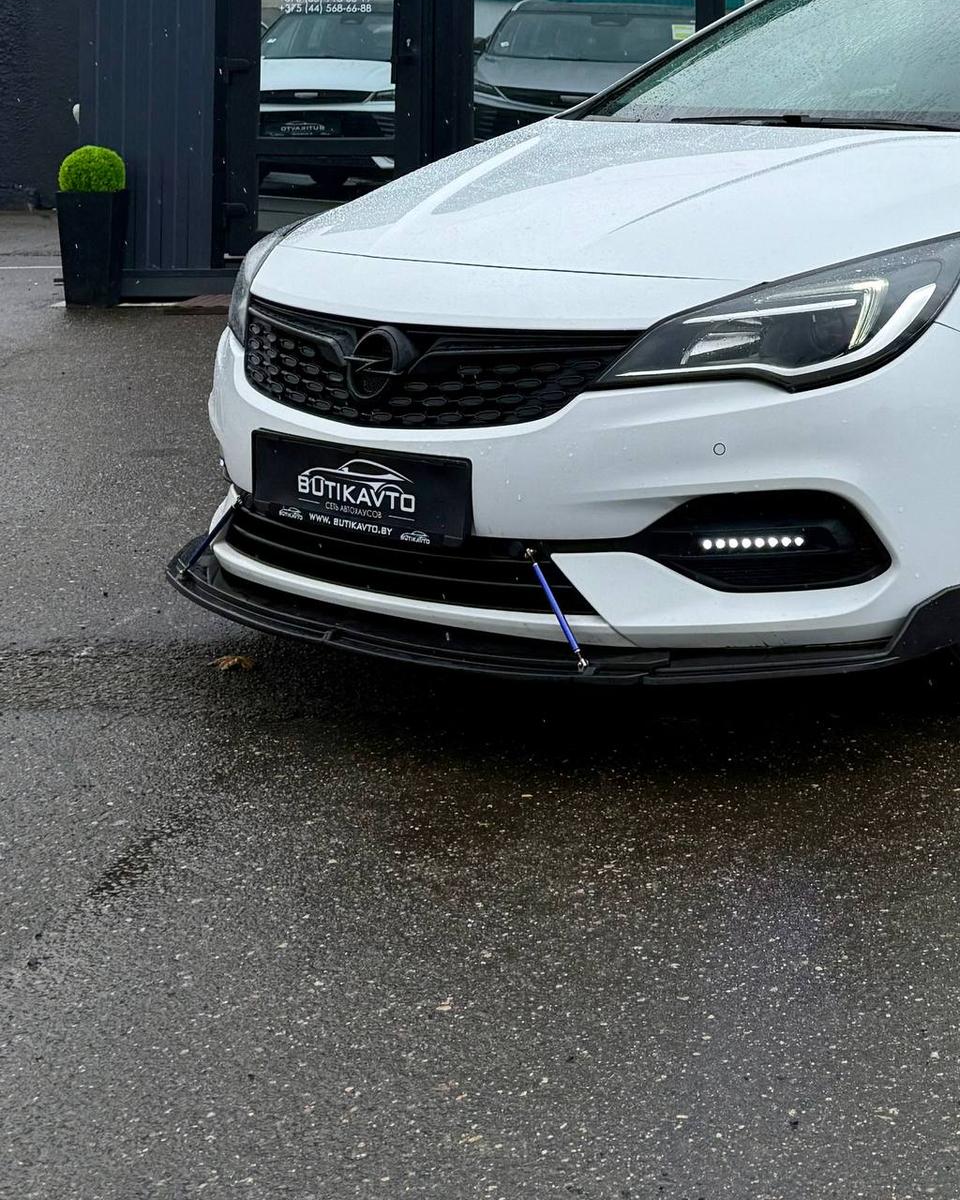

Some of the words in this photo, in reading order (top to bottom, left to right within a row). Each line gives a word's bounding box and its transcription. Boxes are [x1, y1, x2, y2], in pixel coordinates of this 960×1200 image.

[305, 3, 323, 14] (44)
[325, 4, 372, 13] 568-66-88
[298, 474, 416, 513] BUTIKAVTO
[309, 512, 331, 525] WWW.
[333, 518, 393, 536] BUTIKAVTO.BY
